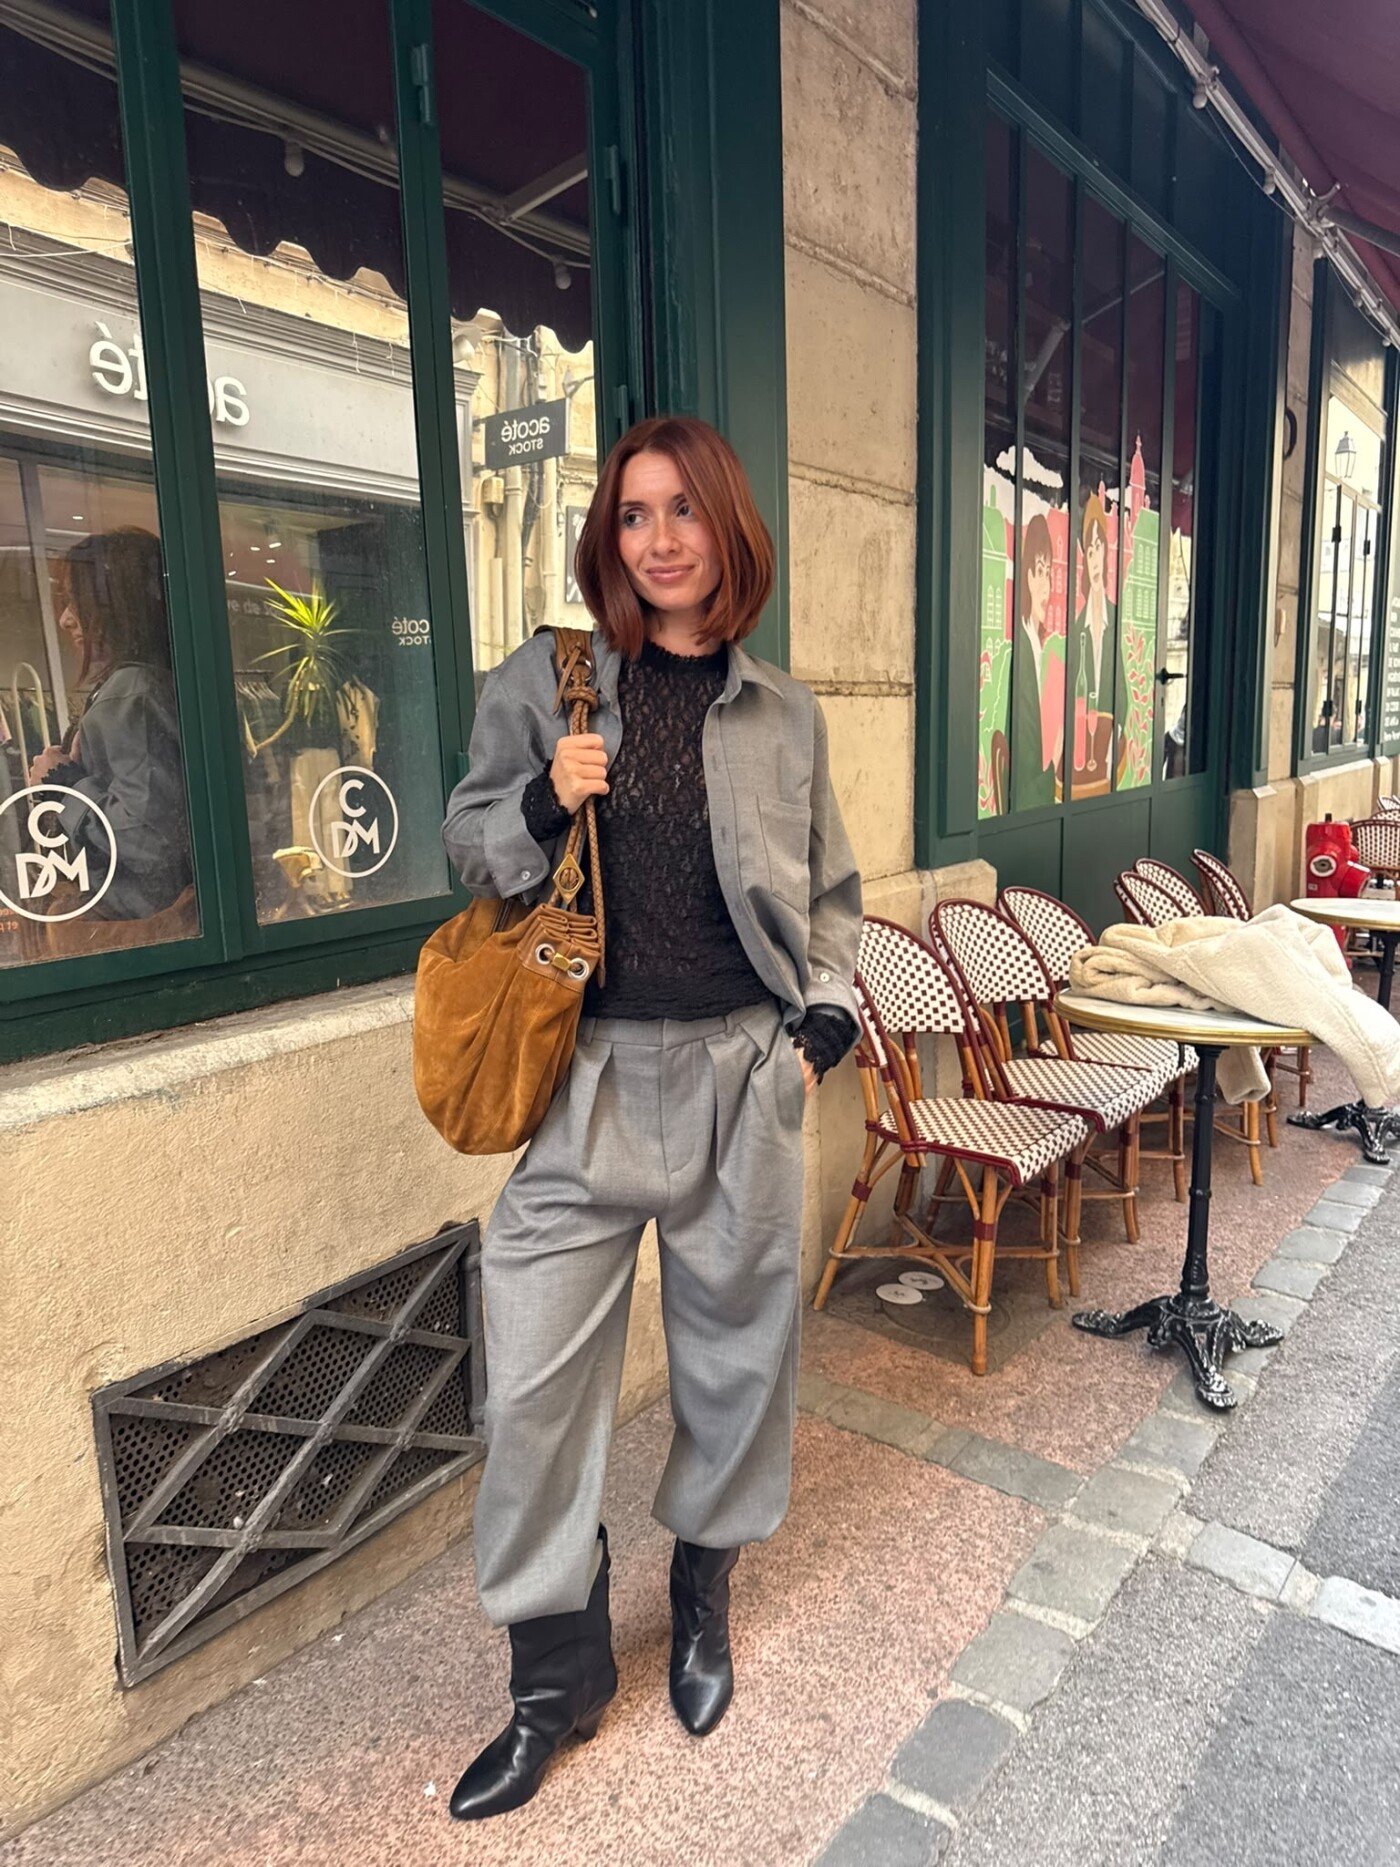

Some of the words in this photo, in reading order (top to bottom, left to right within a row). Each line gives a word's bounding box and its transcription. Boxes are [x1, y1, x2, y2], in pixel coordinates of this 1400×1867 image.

[339, 779, 367, 818] C
[27, 800, 70, 848] C
[331, 817, 381, 859] DM
[15, 846, 91, 900] DM
